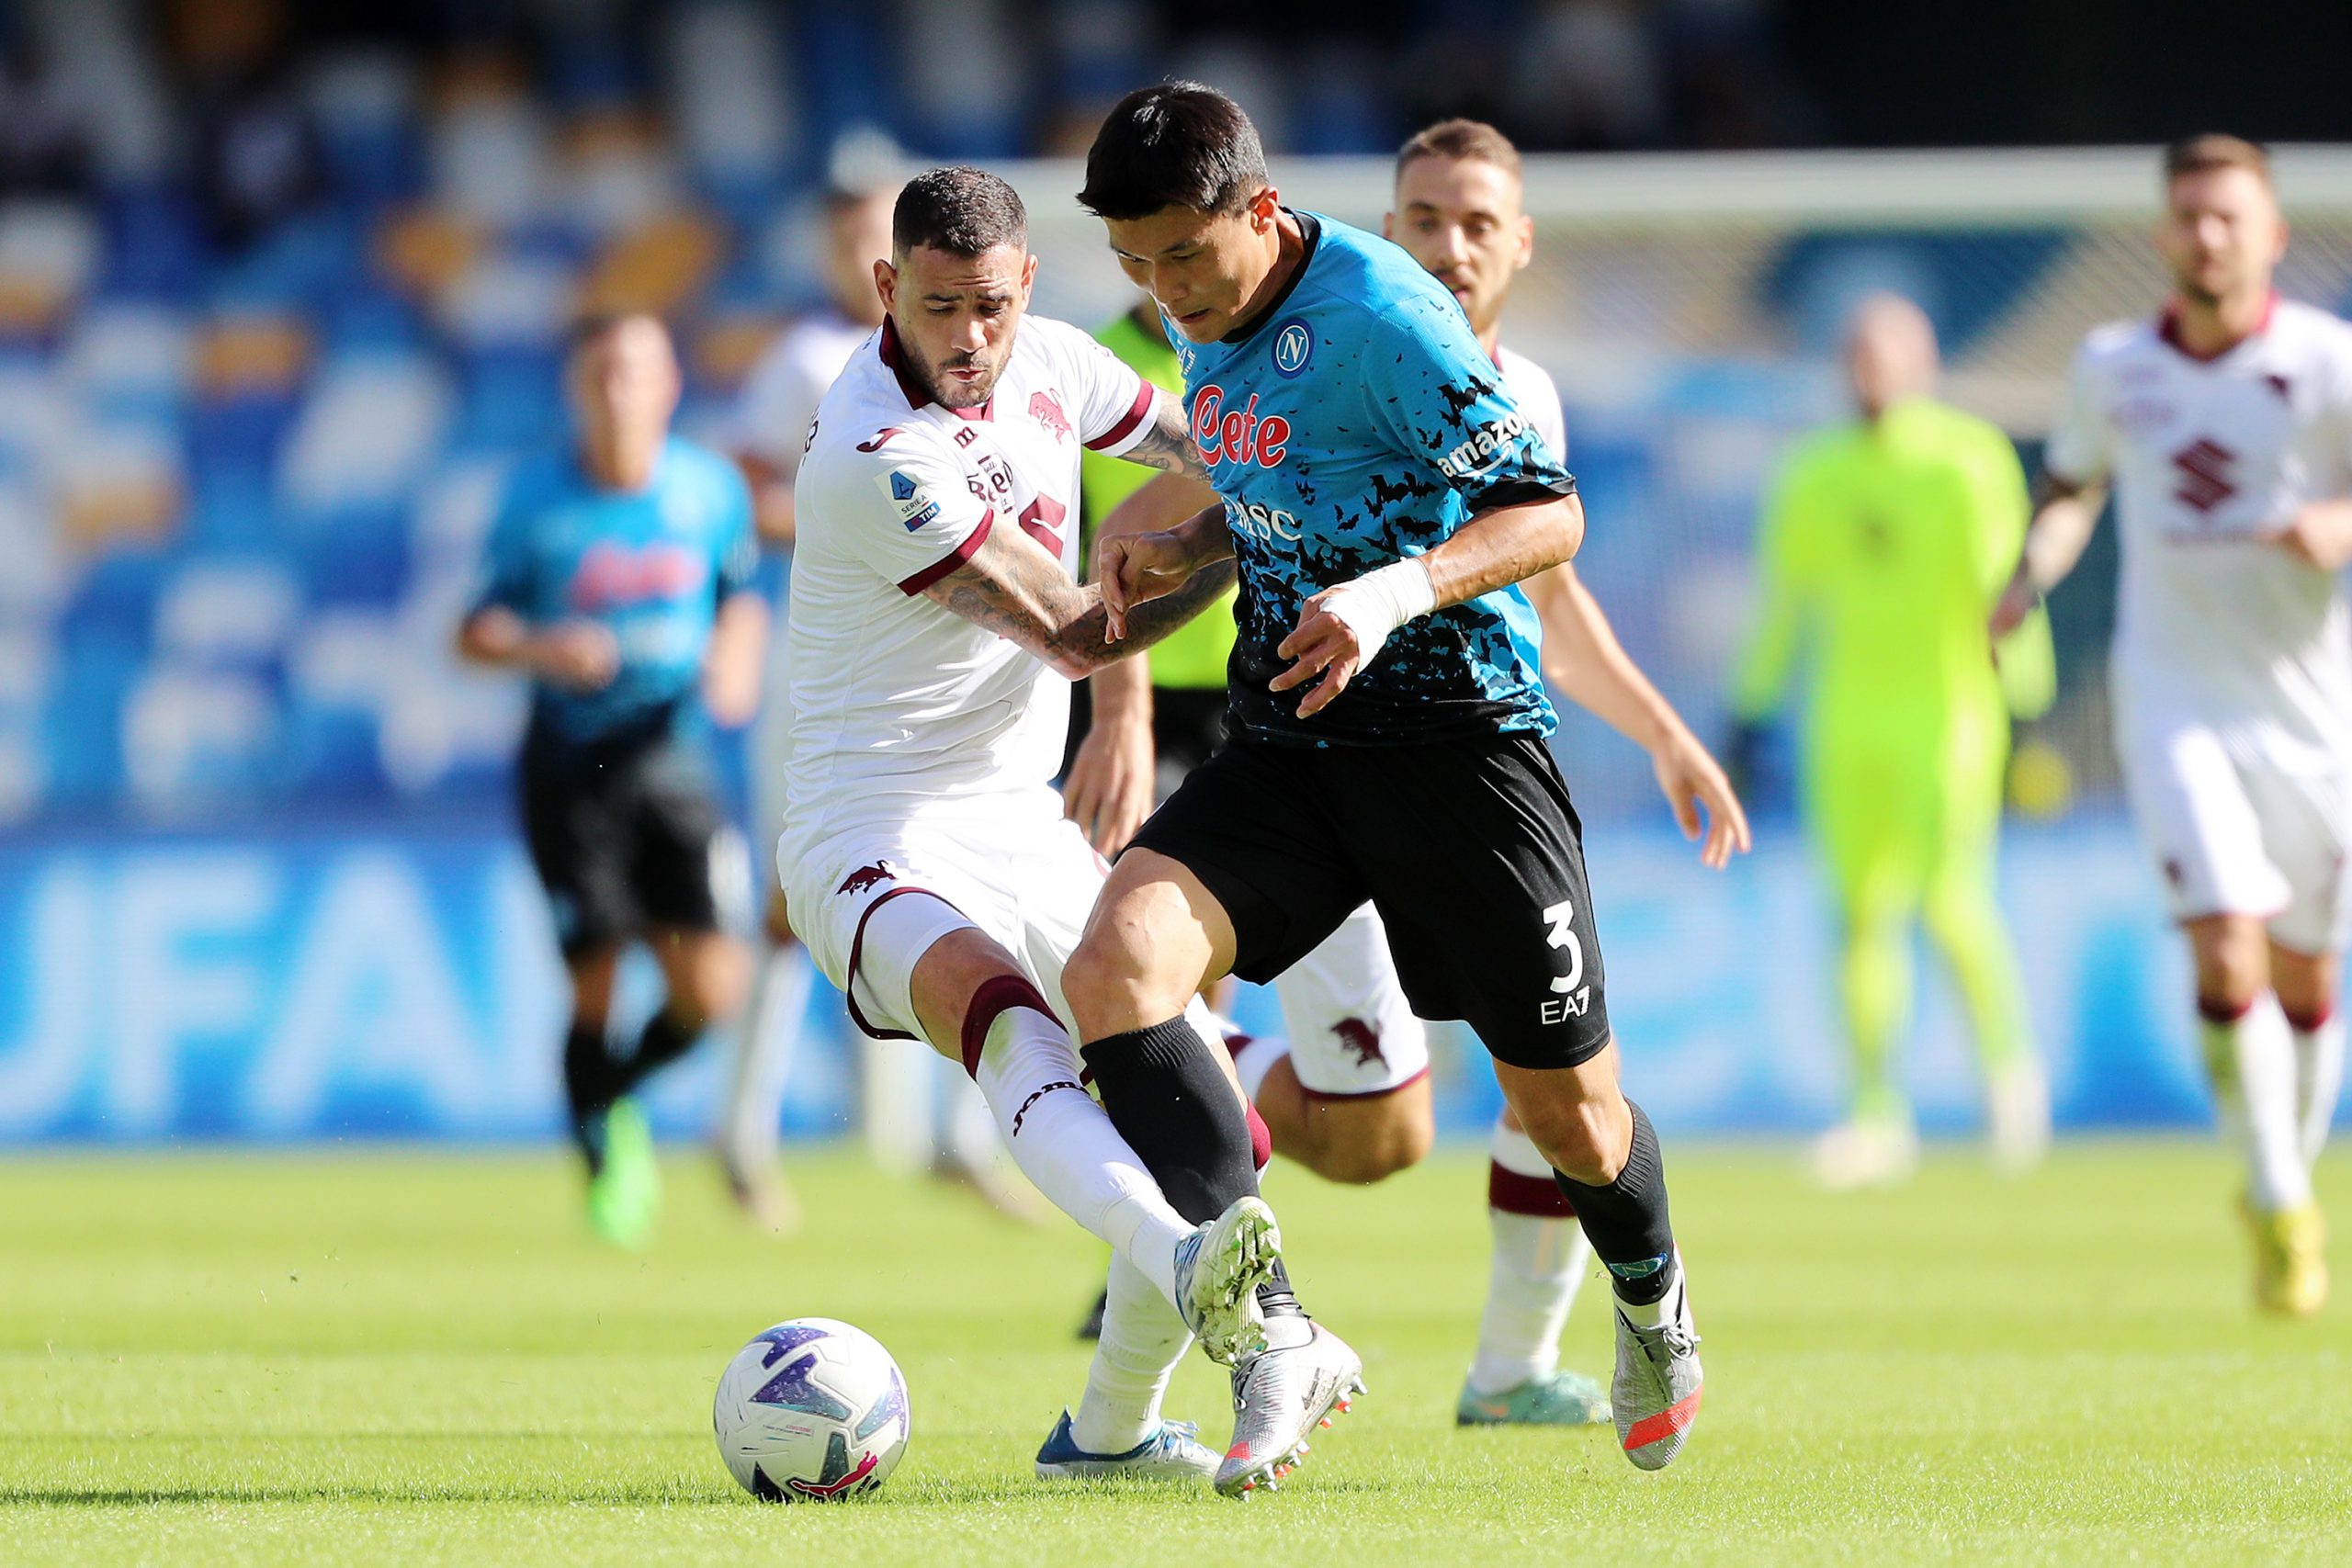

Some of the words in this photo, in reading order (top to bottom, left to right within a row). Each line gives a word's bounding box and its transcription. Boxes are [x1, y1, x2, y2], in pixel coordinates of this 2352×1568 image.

[1437, 412, 1530, 478] amazo
[900, 499, 922, 514] SERIE
[919, 505, 937, 522] TIM
[1542, 899, 1584, 994] 3
[1541, 985, 1590, 1025] EA7
